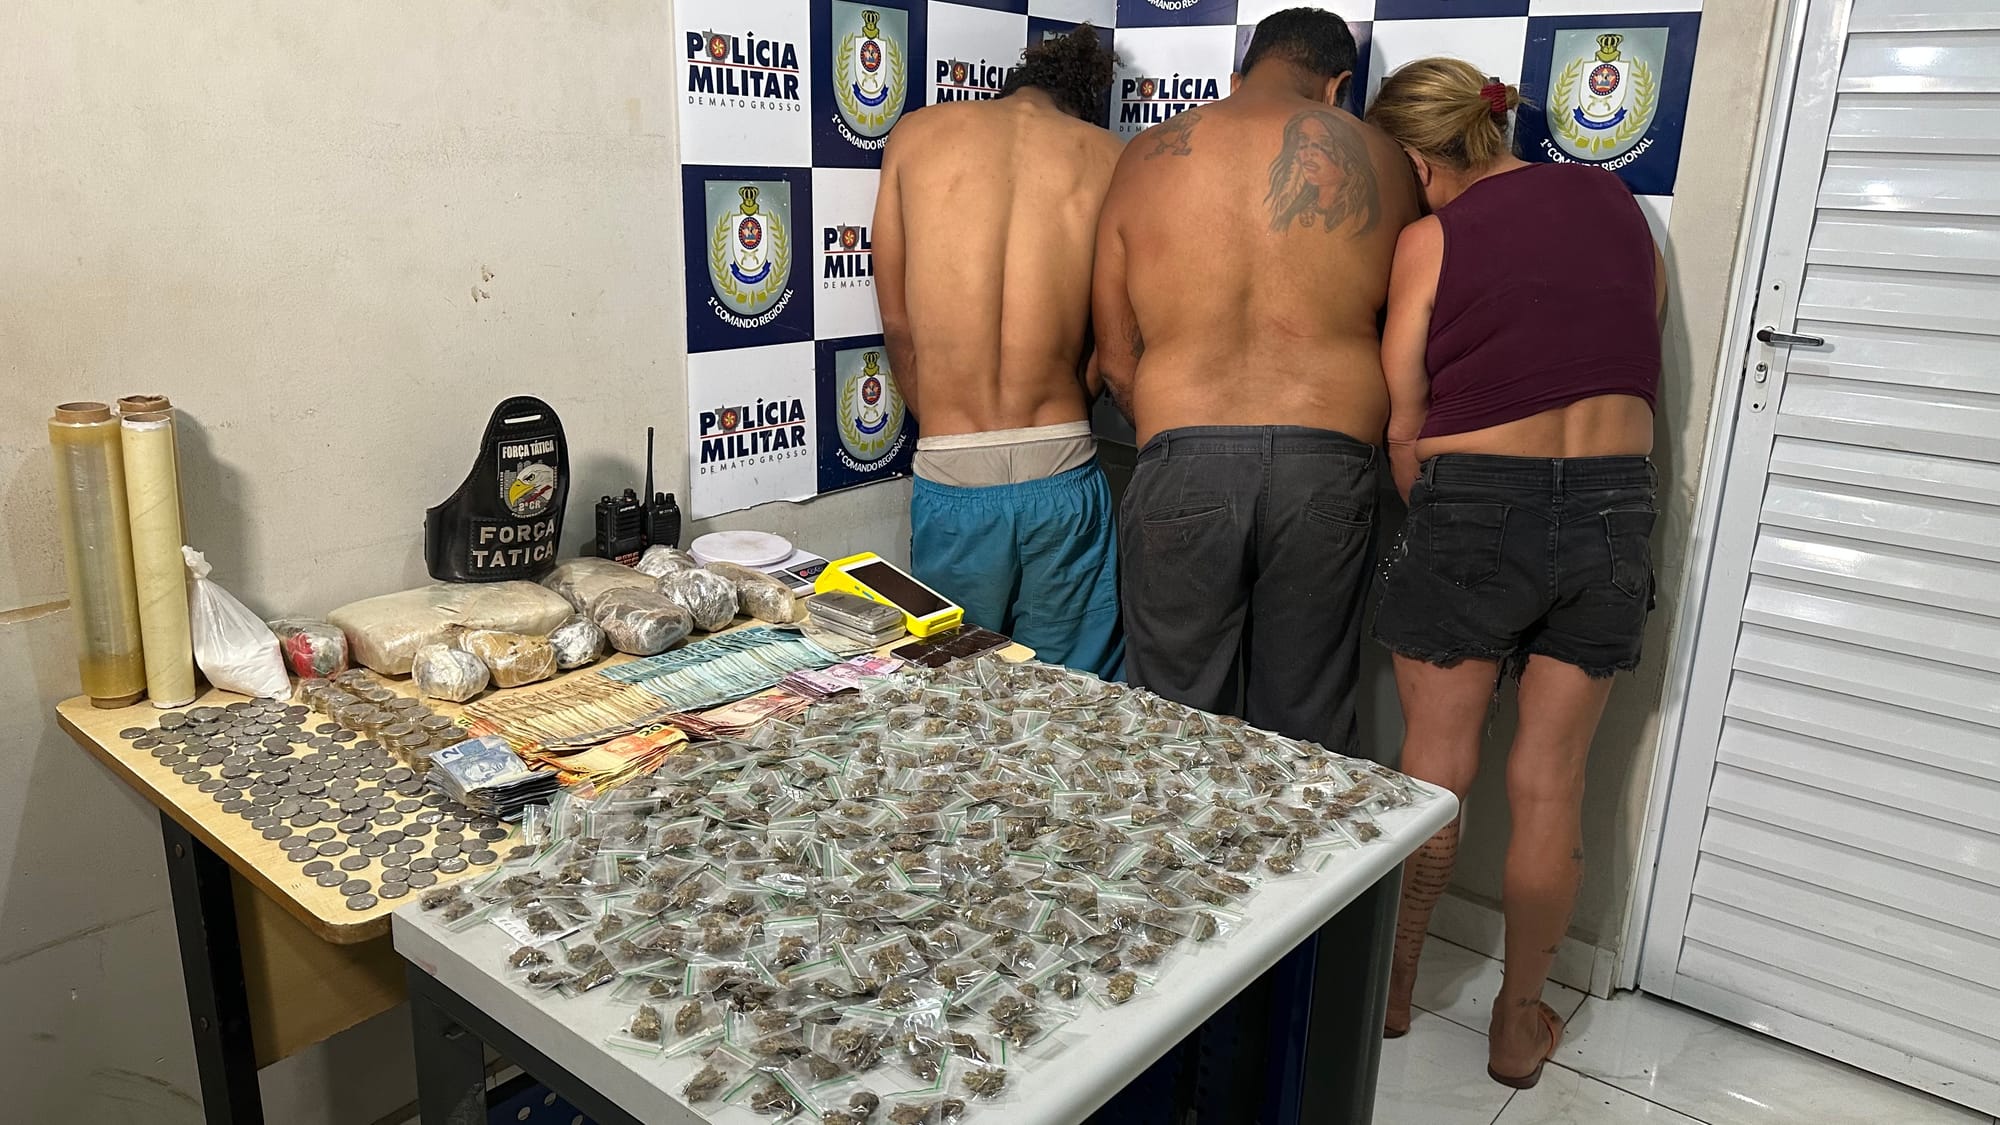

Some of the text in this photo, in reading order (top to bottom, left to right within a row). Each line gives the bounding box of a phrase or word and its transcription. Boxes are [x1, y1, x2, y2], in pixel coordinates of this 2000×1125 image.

[688, 65, 800, 100] MILITAR
[688, 96, 801, 112] DE MATO GROSSO
[1119, 103, 1198, 123] MILIT
[838, 124, 877, 150] COMANDO
[1601, 137, 1654, 172] REGIONAL
[824, 280, 871, 289] DE MATO
[715, 305, 759, 329] COMANDO
[759, 288, 794, 326] REGIONAL
[502, 439, 555, 460] FORÇA TÁTICA
[700, 425, 806, 464] MILITAR
[841, 455, 878, 473] COMANDO
[877, 434, 907, 469] REGIONAL
[700, 448, 807, 475] DE MATO GROSSO
[479, 518, 555, 545] FORÇA
[472, 540, 554, 568] TATICA
[639, 724, 662, 737] 20
[441, 747, 460, 759] 2
